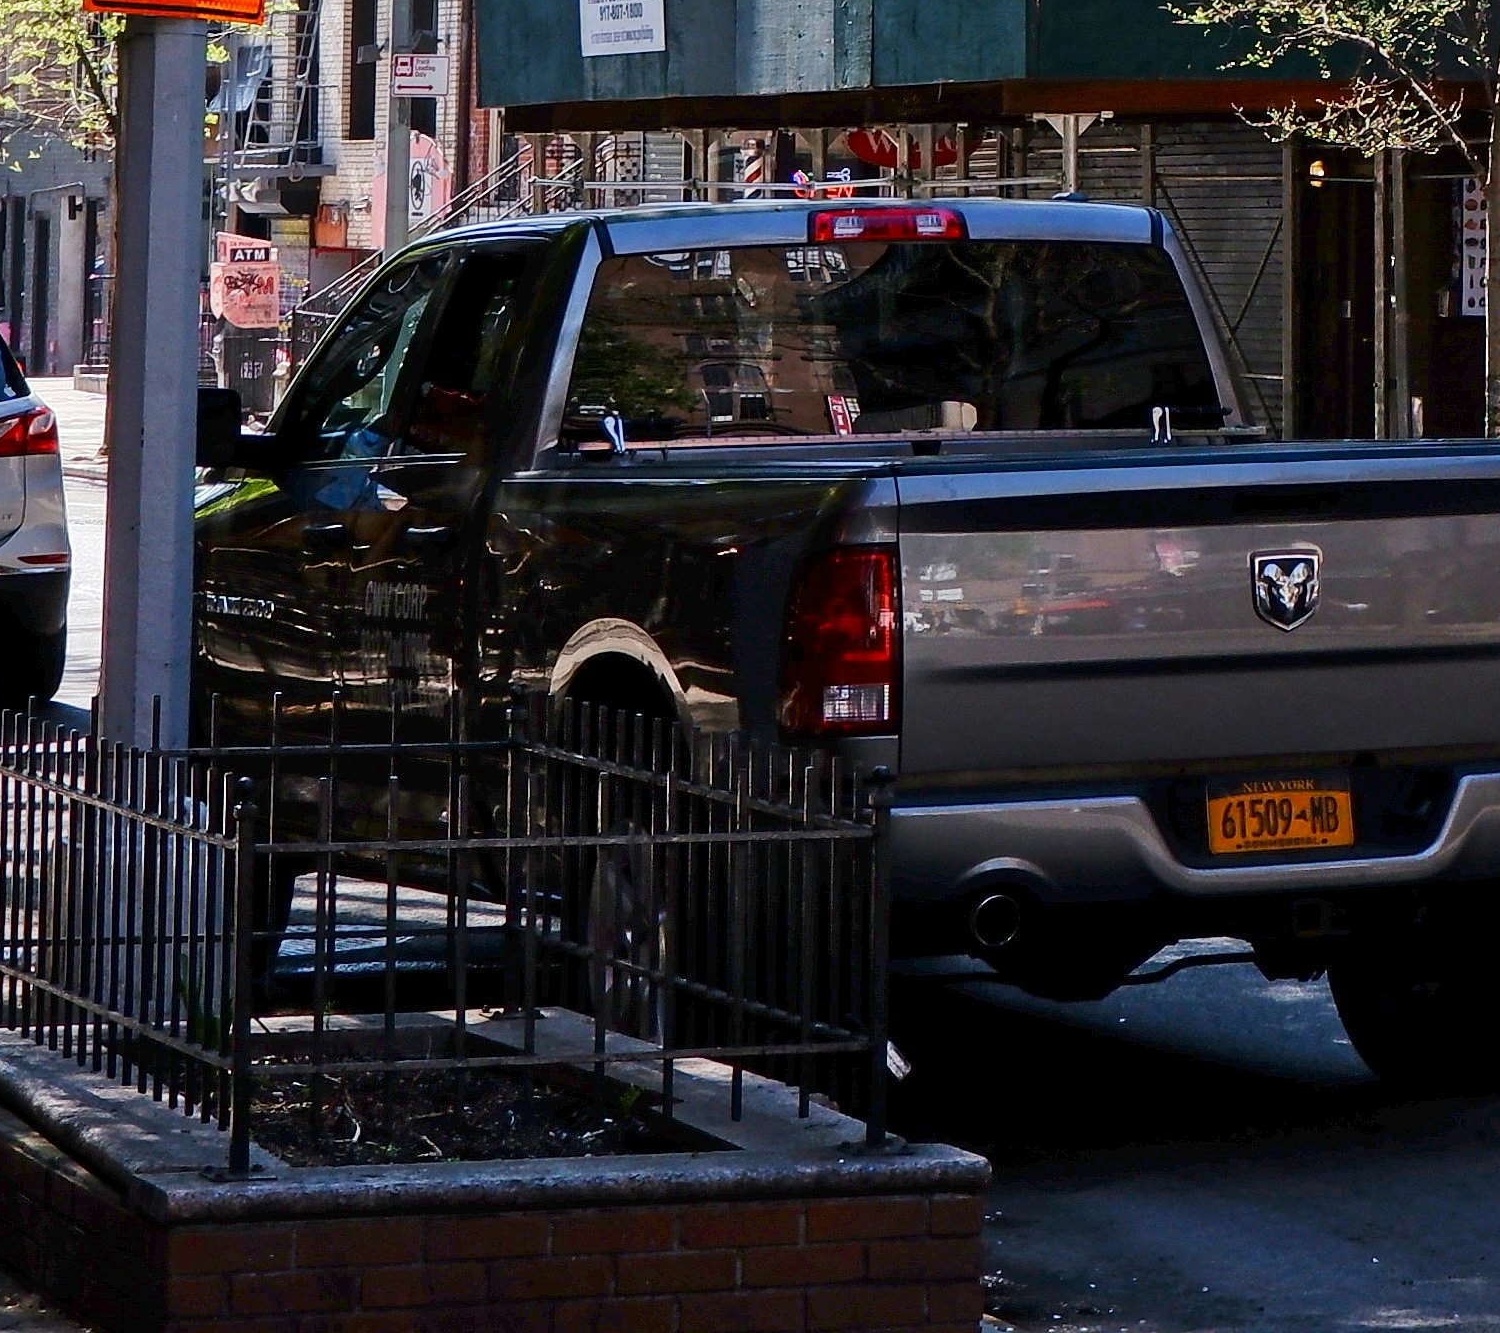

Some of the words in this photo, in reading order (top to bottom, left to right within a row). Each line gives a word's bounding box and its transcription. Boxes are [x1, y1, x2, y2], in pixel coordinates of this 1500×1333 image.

[234, 249, 266, 262] ATM
[1243, 781, 1274, 793] NEW
[1279, 779, 1315, 791] YORK
[1221, 798, 1293, 839] 61509
[1309, 796, 1340, 834] MB
